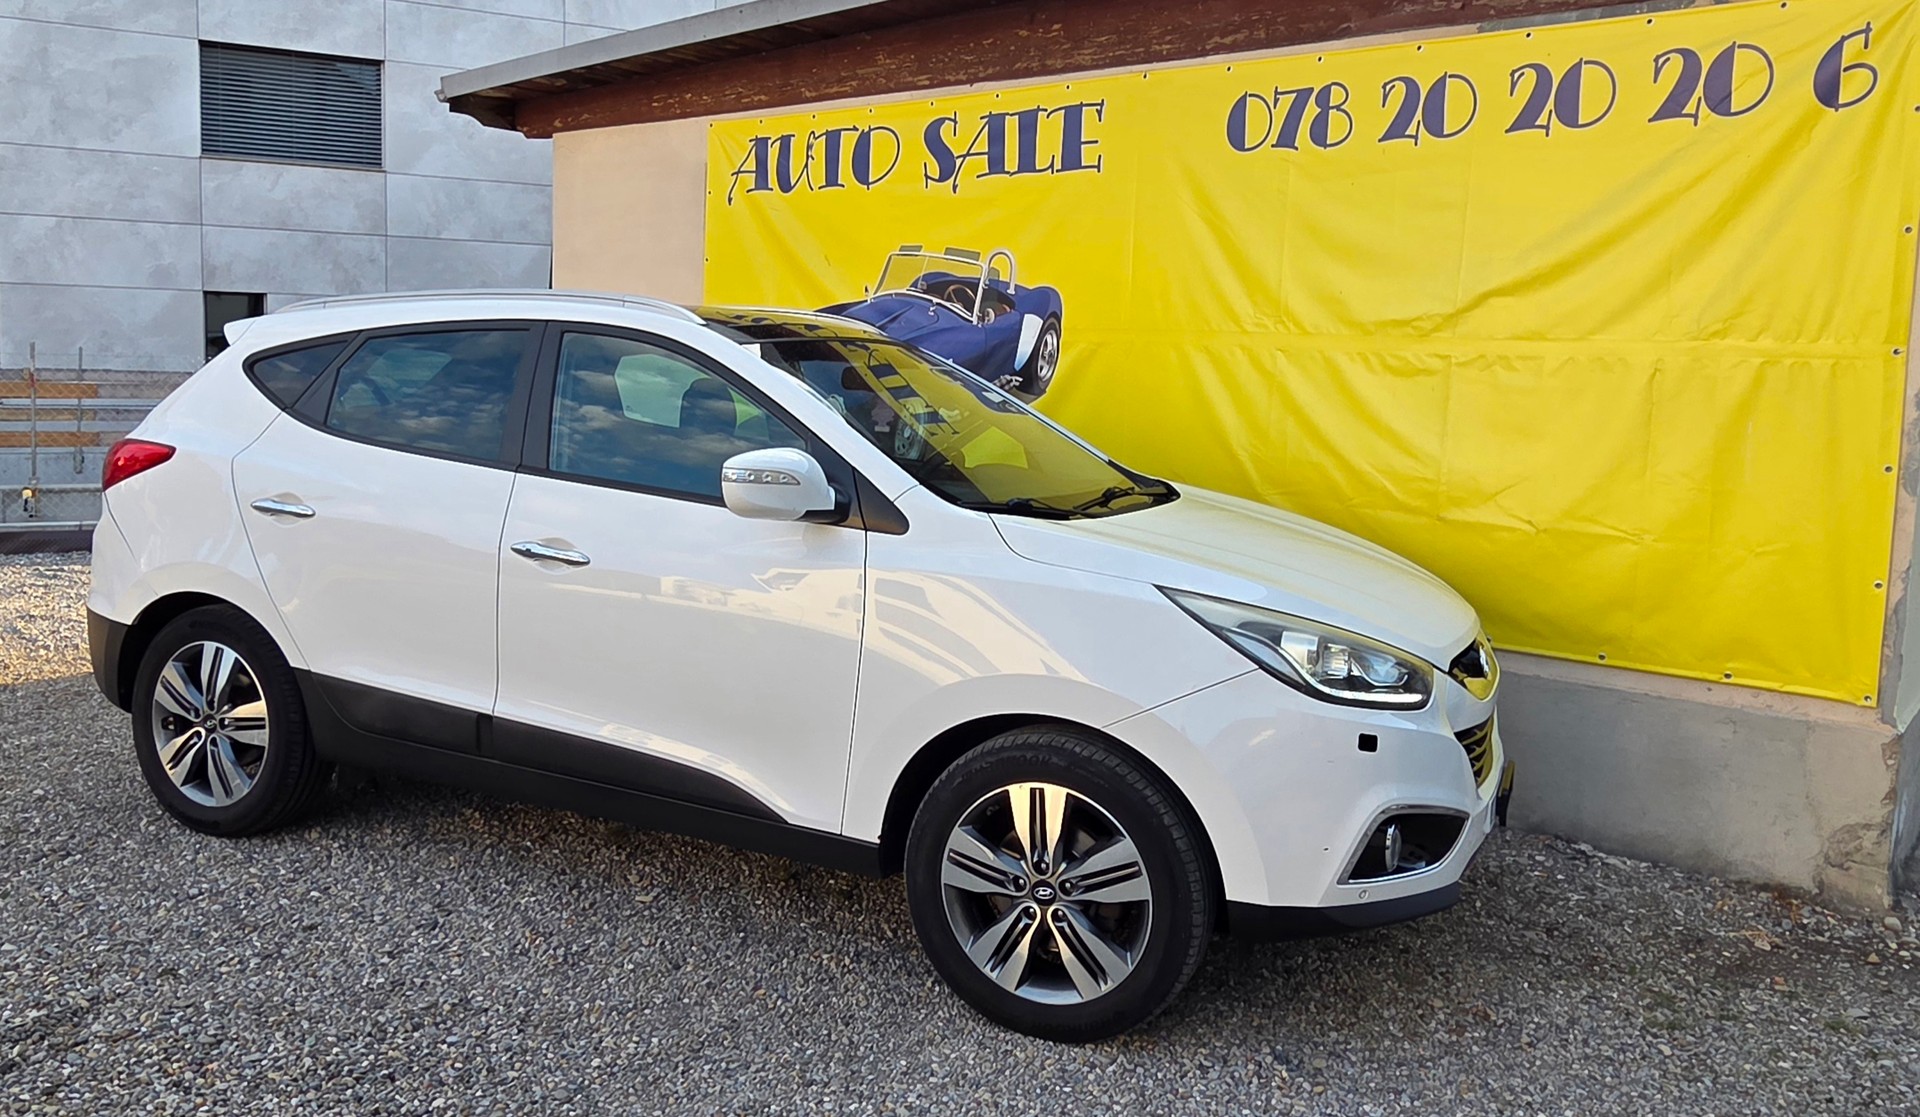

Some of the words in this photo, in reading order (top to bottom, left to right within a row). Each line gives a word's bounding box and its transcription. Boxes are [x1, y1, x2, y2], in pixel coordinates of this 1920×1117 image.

[1227, 82, 1353, 153] 078
[1378, 72, 1478, 147] 20
[1505, 58, 1617, 138] 20
[1648, 42, 1774, 126] 20
[1814, 22, 1878, 111] 6
[728, 125, 901, 205] AUTO
[924, 99, 1105, 193] SALE
